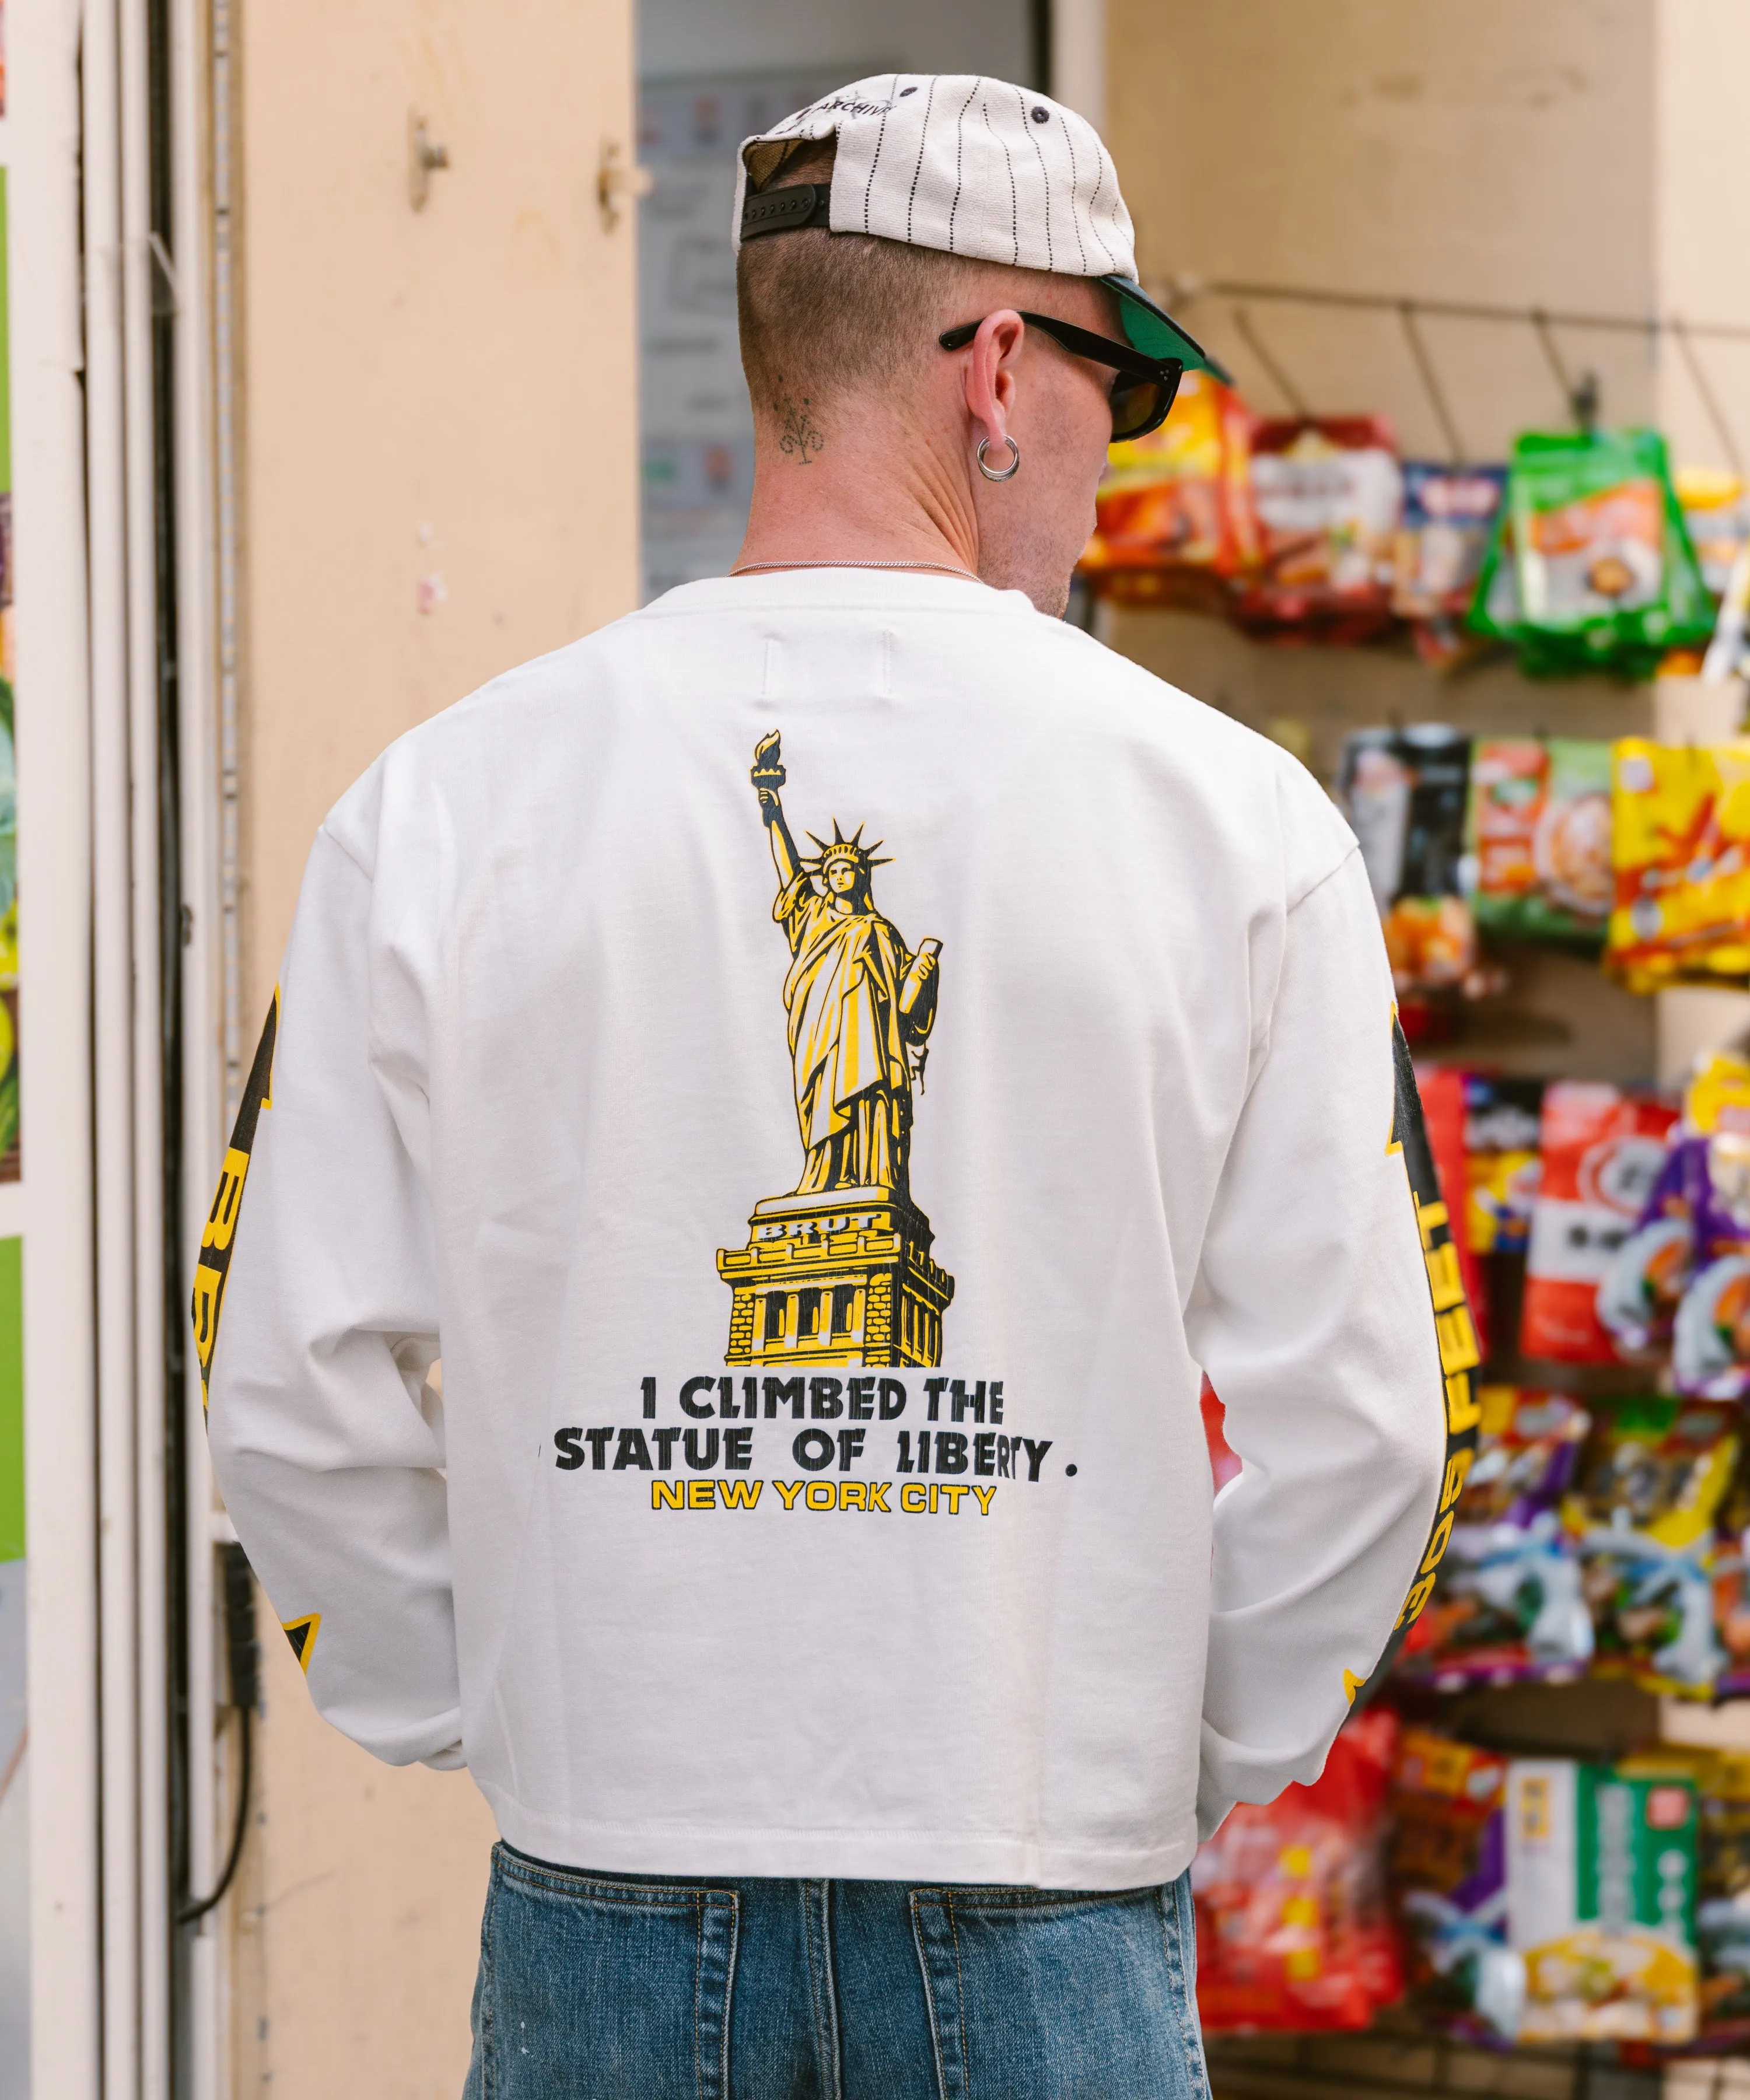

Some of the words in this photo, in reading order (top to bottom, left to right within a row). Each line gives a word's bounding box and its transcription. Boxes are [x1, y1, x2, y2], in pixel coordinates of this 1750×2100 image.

[758, 1213, 882, 1240] BRUT
[1413, 1191, 1481, 1435] FEET
[679, 1376, 907, 1420] CLIMBED
[923, 1377, 1004, 1424] THE
[554, 1427, 753, 1471] STATUE
[792, 1428, 866, 1472] OF
[651, 1479, 764, 1510] NEW
[771, 1480, 892, 1513] YORK
[900, 1482, 997, 1516] CITY
[1393, 1447, 1475, 1630] 305
